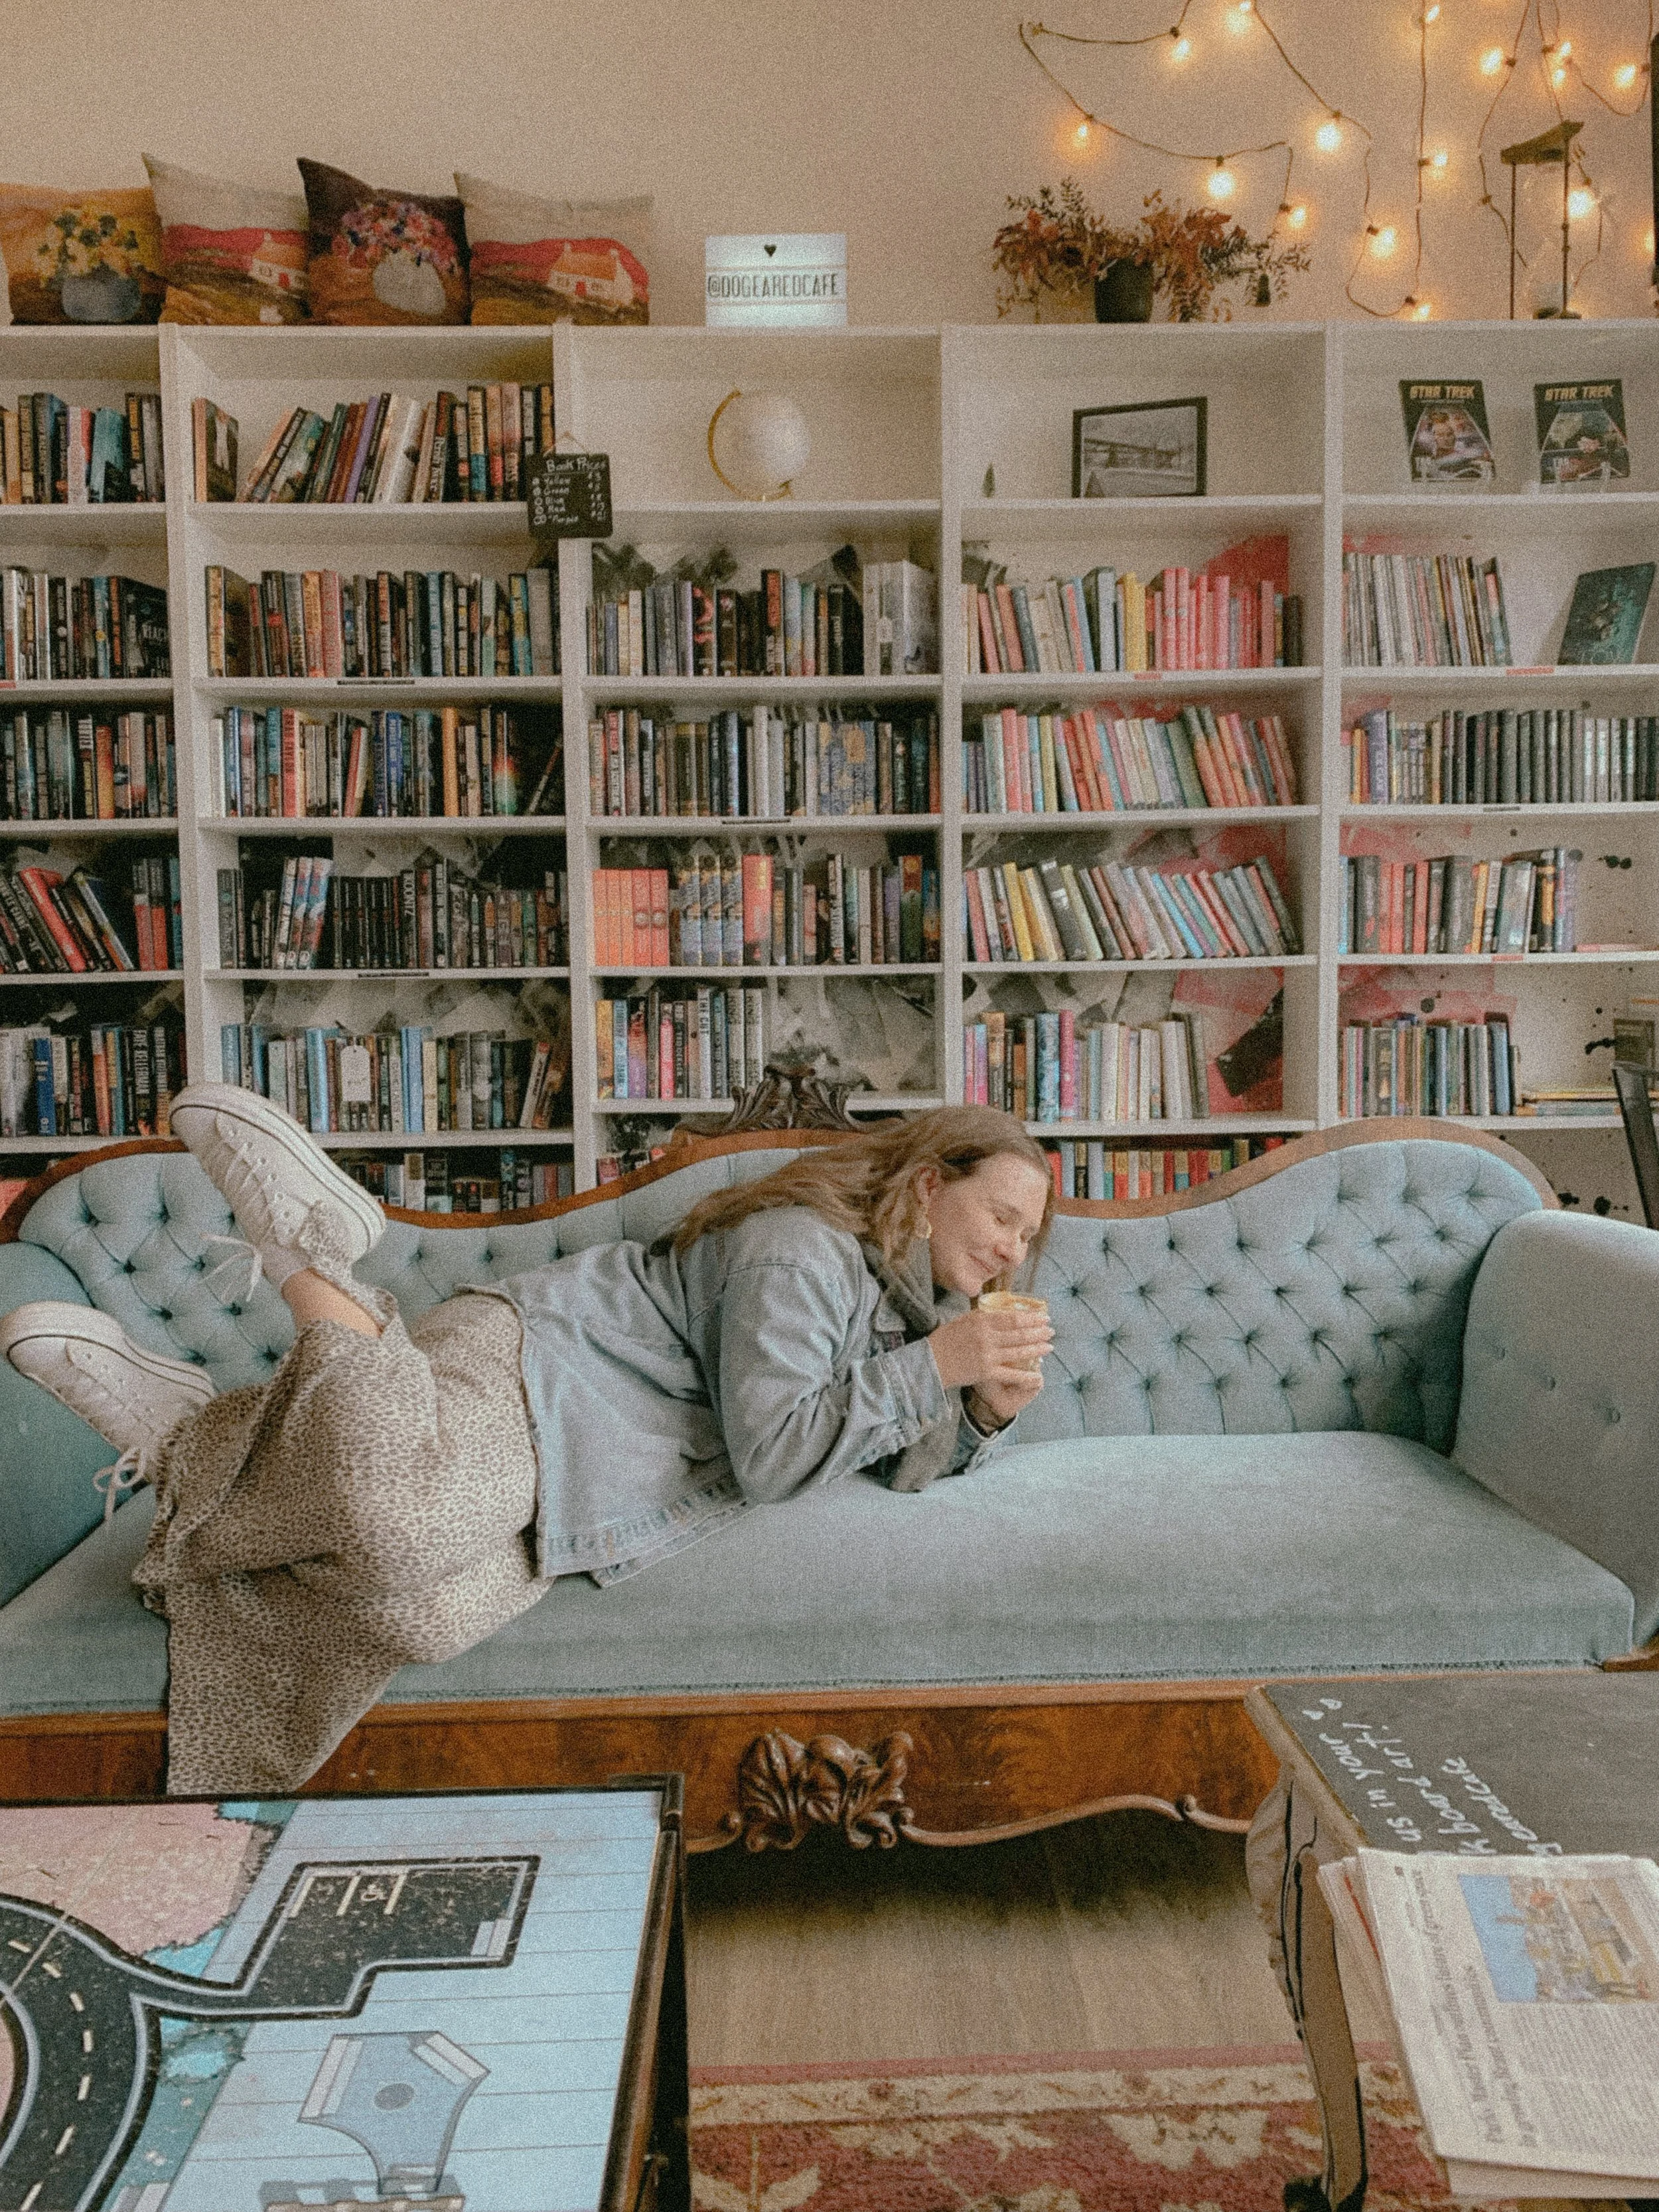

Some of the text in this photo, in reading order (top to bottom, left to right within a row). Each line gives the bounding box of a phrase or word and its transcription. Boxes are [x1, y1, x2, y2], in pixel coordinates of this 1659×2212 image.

[707, 273, 839, 299] @DOGEAREDCAFE
[1409, 384, 1475, 399] STAR TREK
[1545, 384, 1614, 402] STAR TREK
[699, 997, 709, 1034] THE CUT
[133, 1029, 150, 1094] FAYE KELLERMAN
[1319, 1732, 1422, 1842] us in your
